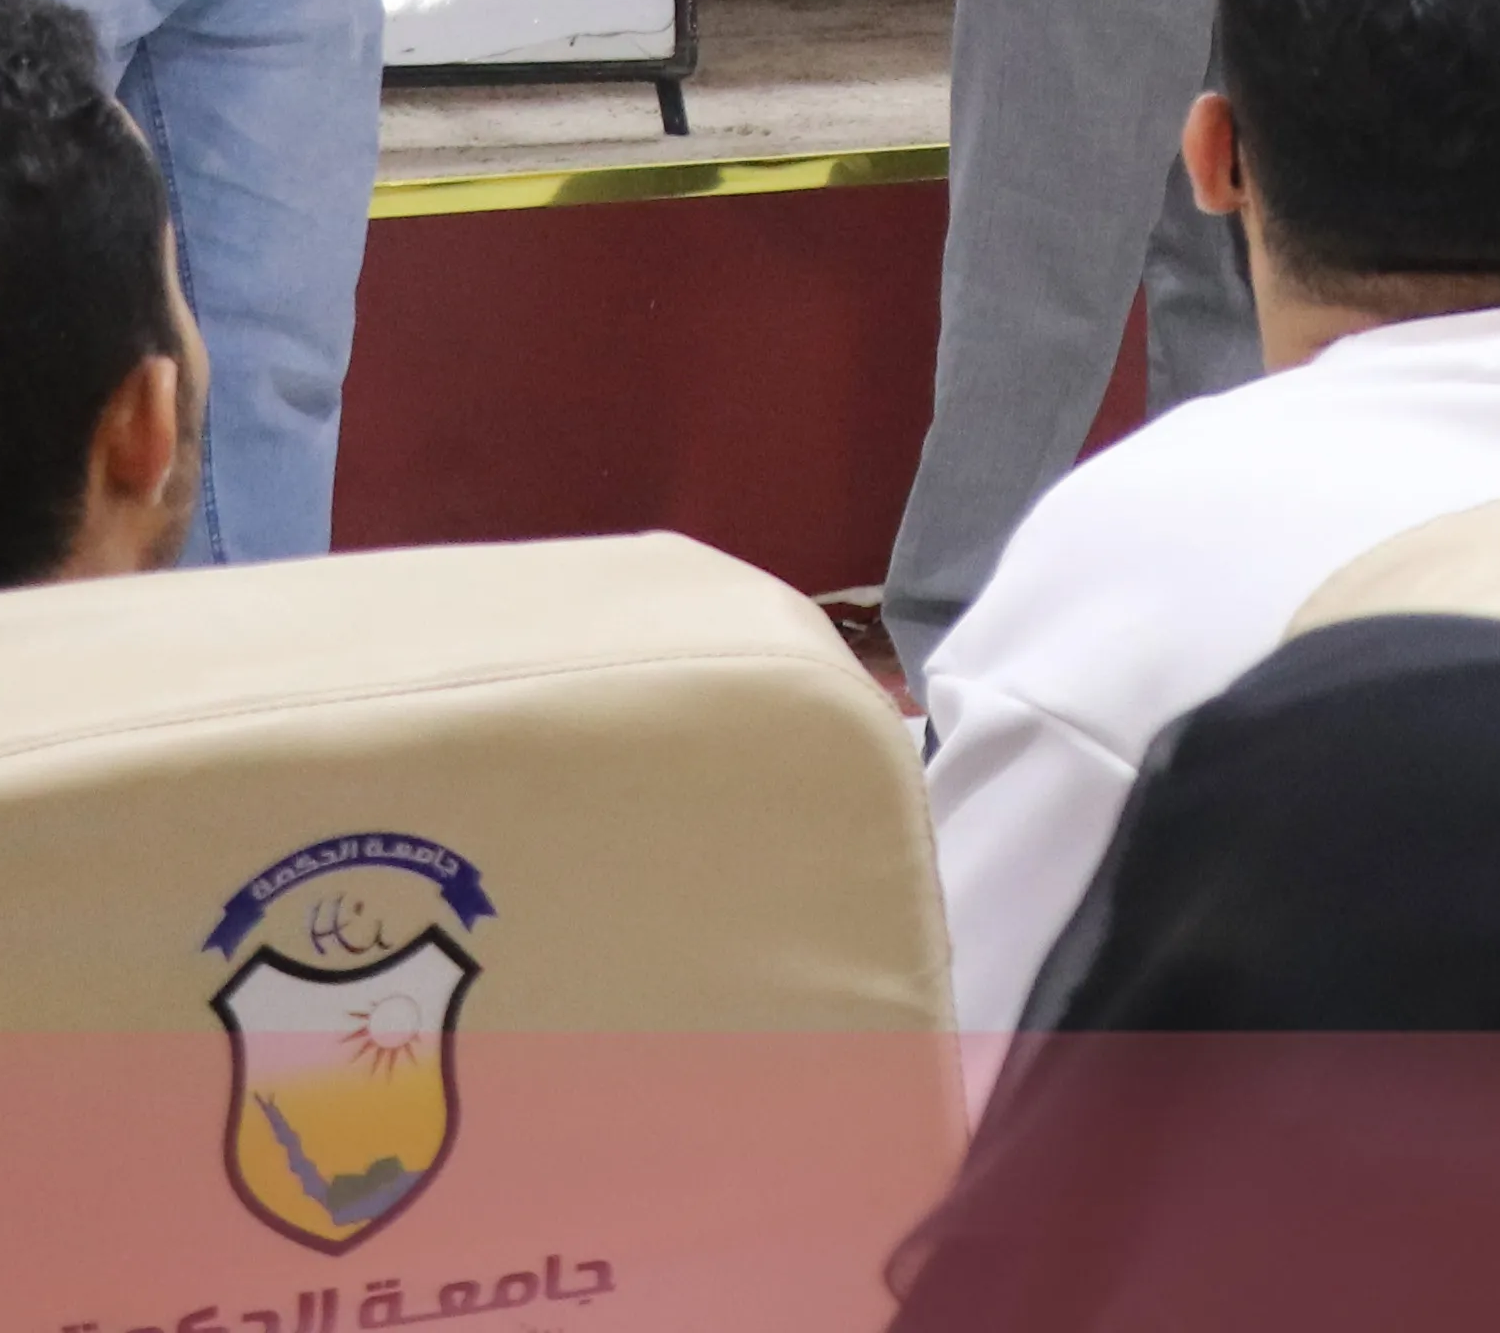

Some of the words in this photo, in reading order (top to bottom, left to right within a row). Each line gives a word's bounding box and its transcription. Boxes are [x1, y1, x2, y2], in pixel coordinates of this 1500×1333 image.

[250, 838, 361, 902] الحكمة
[363, 837, 462, 877] جامعة
[357, 1253, 616, 1331] جامعة
